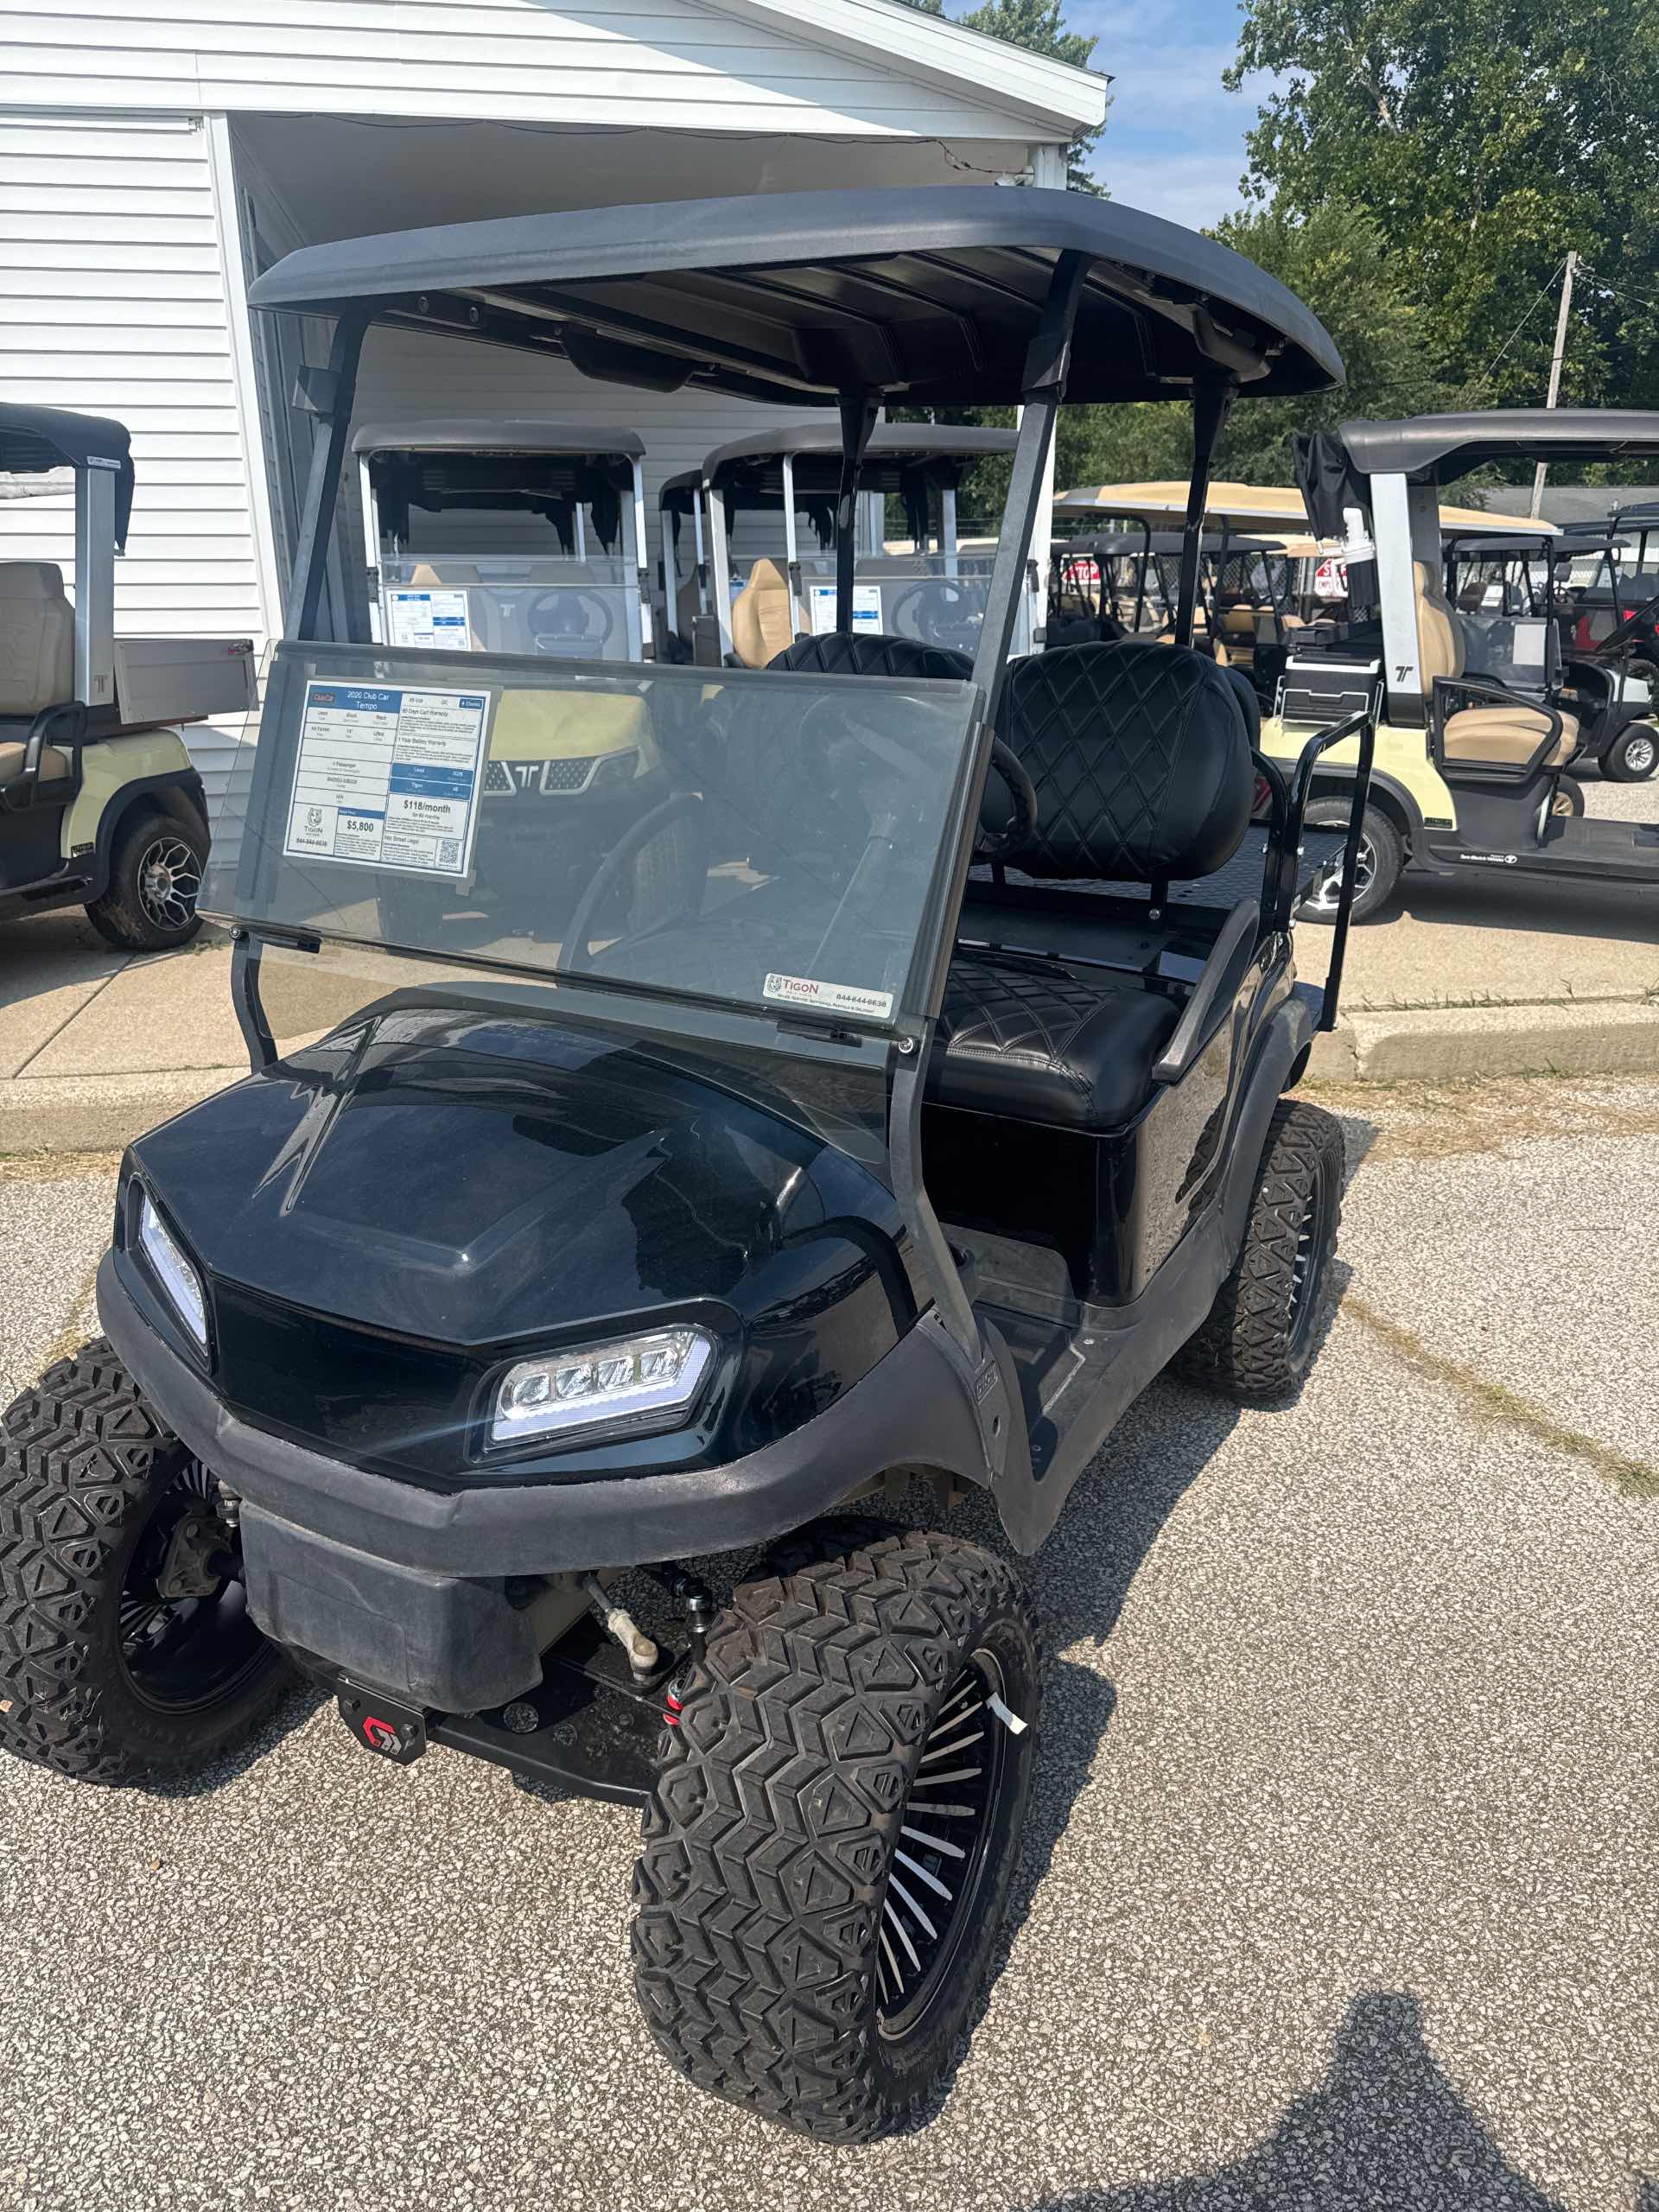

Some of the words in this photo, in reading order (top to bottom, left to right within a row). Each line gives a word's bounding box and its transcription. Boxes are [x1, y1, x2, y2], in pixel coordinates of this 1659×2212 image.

[356, 701, 378, 711] Tempo
[404, 800, 451, 813] $118/month
[347, 820, 374, 832] $5,800
